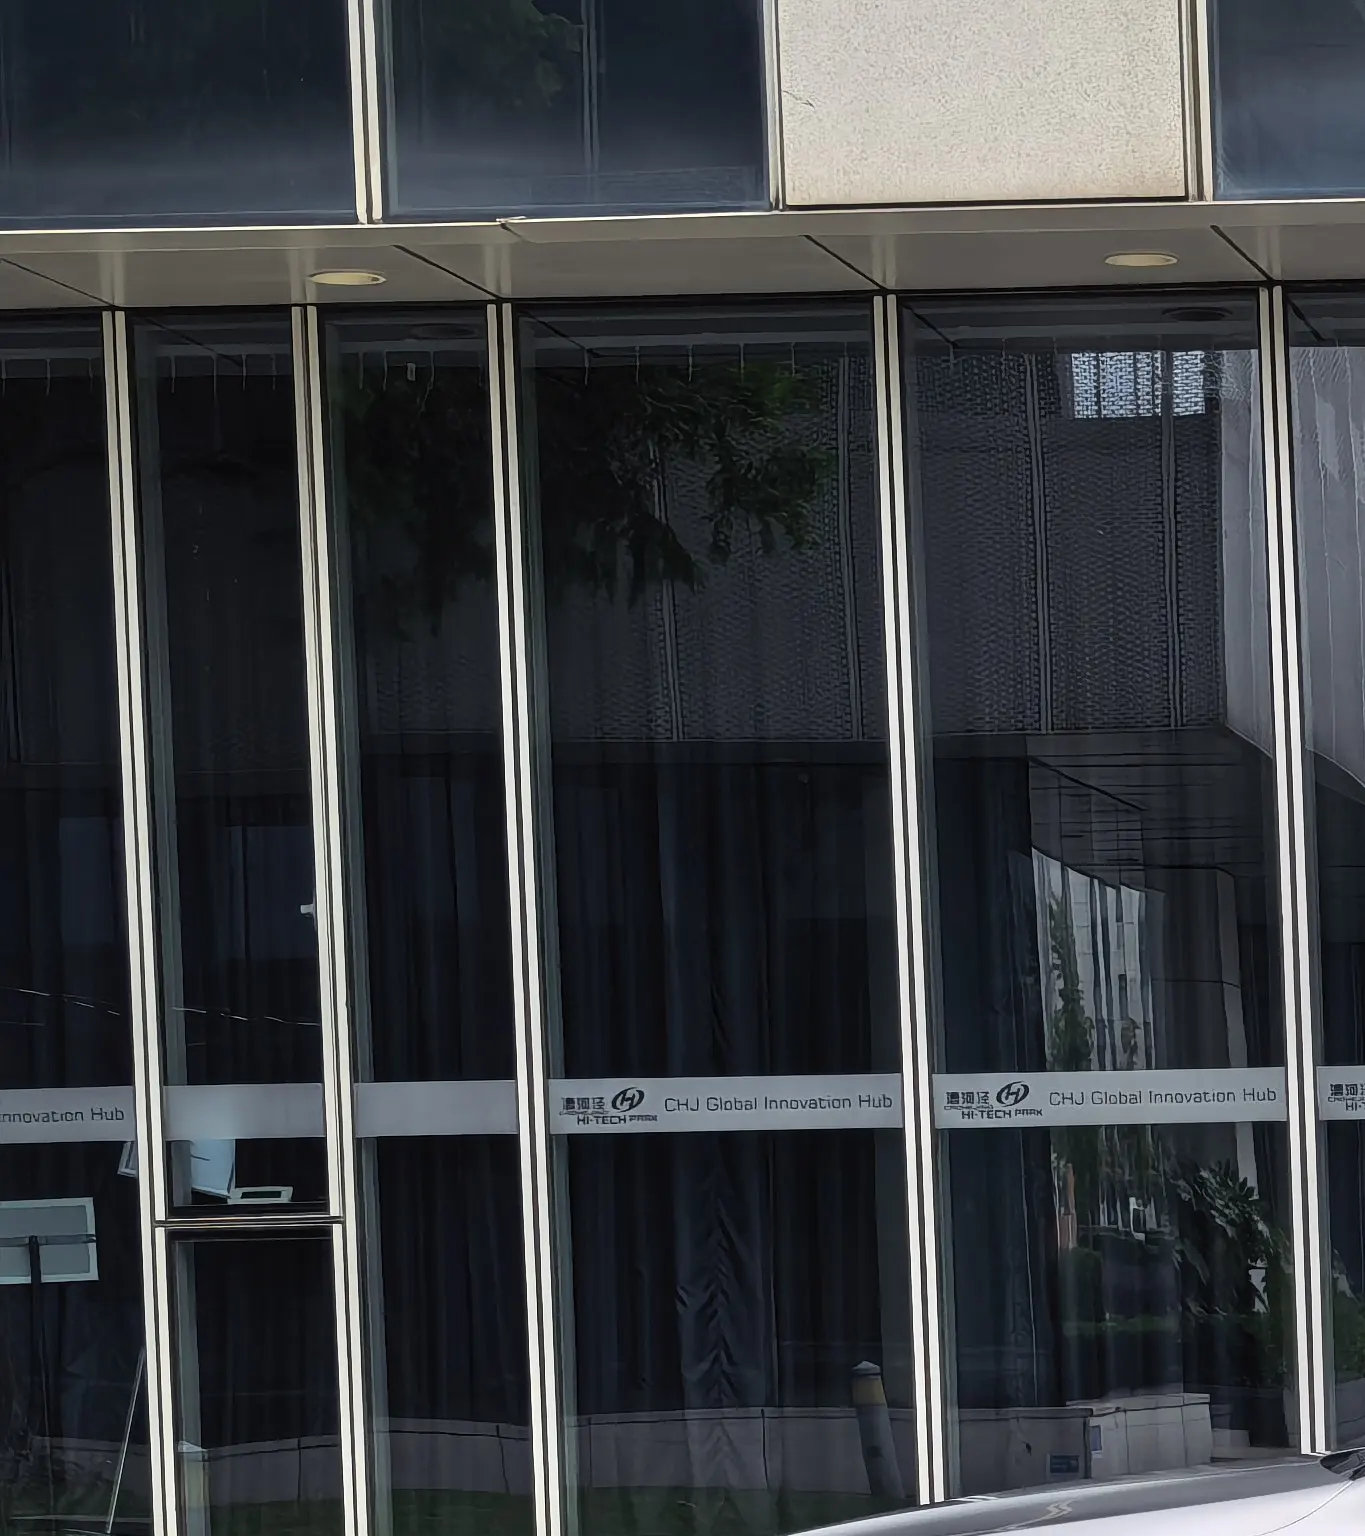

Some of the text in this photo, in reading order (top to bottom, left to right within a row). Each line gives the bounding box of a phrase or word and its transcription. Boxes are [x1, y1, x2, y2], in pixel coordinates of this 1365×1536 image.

[664, 1094, 893, 1112] CHJ Global Innovation Hub
[1049, 1087, 1277, 1106] CHJ Global Innovation Hub
[0, 1107, 124, 1123] nnovation Hub
